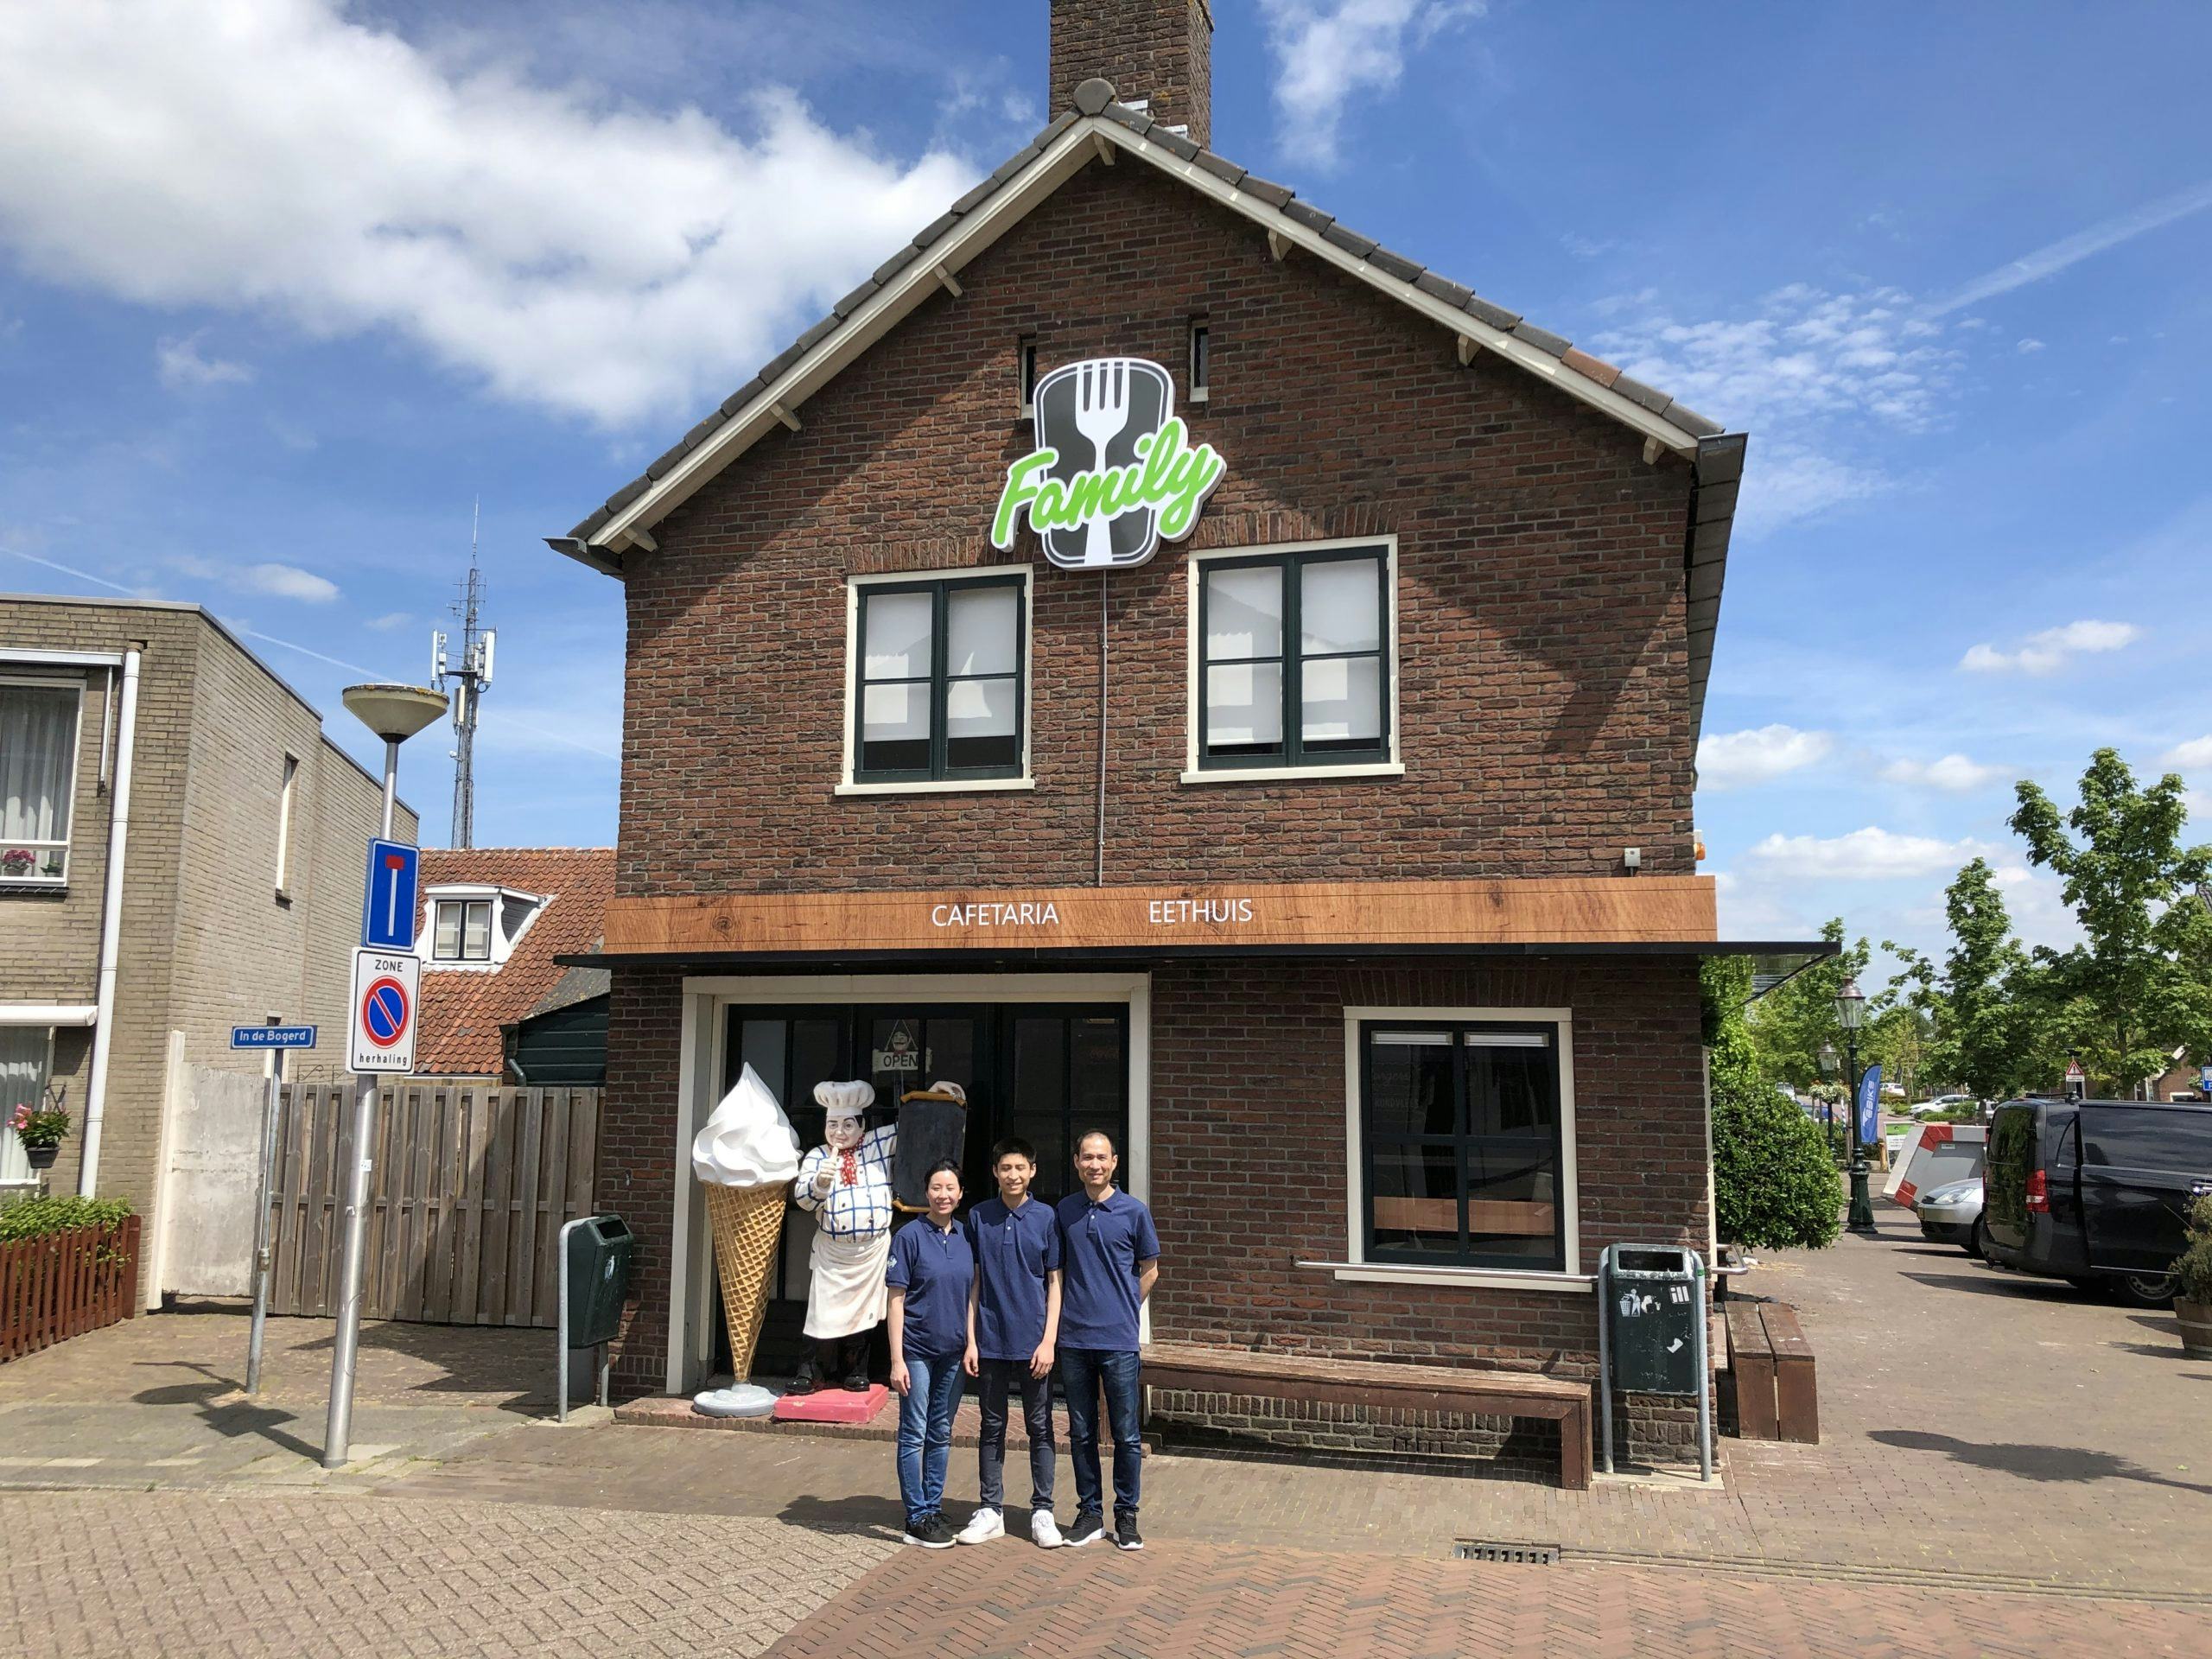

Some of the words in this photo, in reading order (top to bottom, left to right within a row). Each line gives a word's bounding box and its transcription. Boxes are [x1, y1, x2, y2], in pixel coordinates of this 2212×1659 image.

[994, 419, 1221, 545] Family
[931, 903, 1059, 926] CAFETARIA
[1149, 899, 1253, 923] EETHUIS
[375, 959, 403, 972] ZONE
[239, 1031, 249, 1041] In
[251, 1031, 265, 1041] de
[266, 1030, 307, 1044] Bogerd
[359, 1052, 408, 1066] herhaling
[883, 1054, 918, 1067] OPEN
